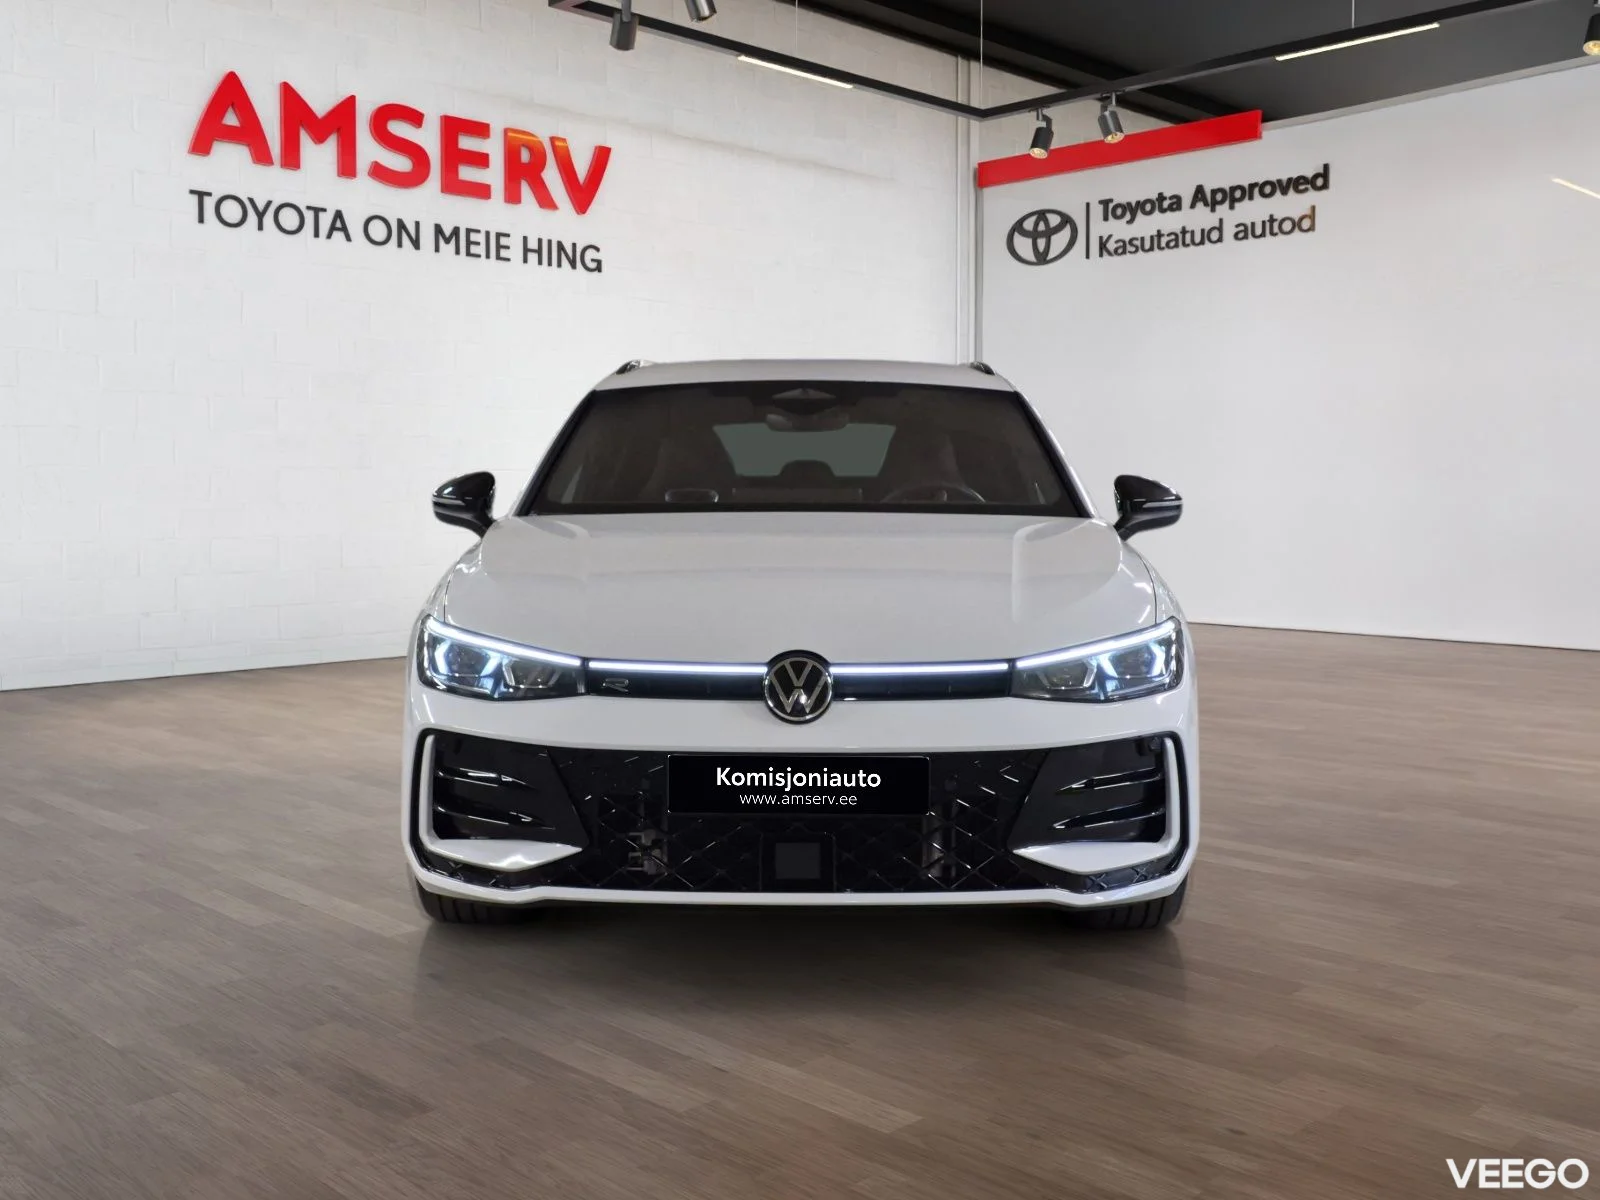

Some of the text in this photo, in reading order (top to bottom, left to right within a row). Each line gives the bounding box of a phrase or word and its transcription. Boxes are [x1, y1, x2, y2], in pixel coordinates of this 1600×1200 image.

[187, 70, 612, 216] AMSERV
[1098, 163, 1331, 225] Toyota Approved
[188, 188, 603, 273] TOYOTA ON MEIE HING
[1099, 205, 1317, 258] Kasutatud autod
[716, 766, 882, 792] Komisjoniauto
[739, 793, 858, 806] www.amserv.ee
